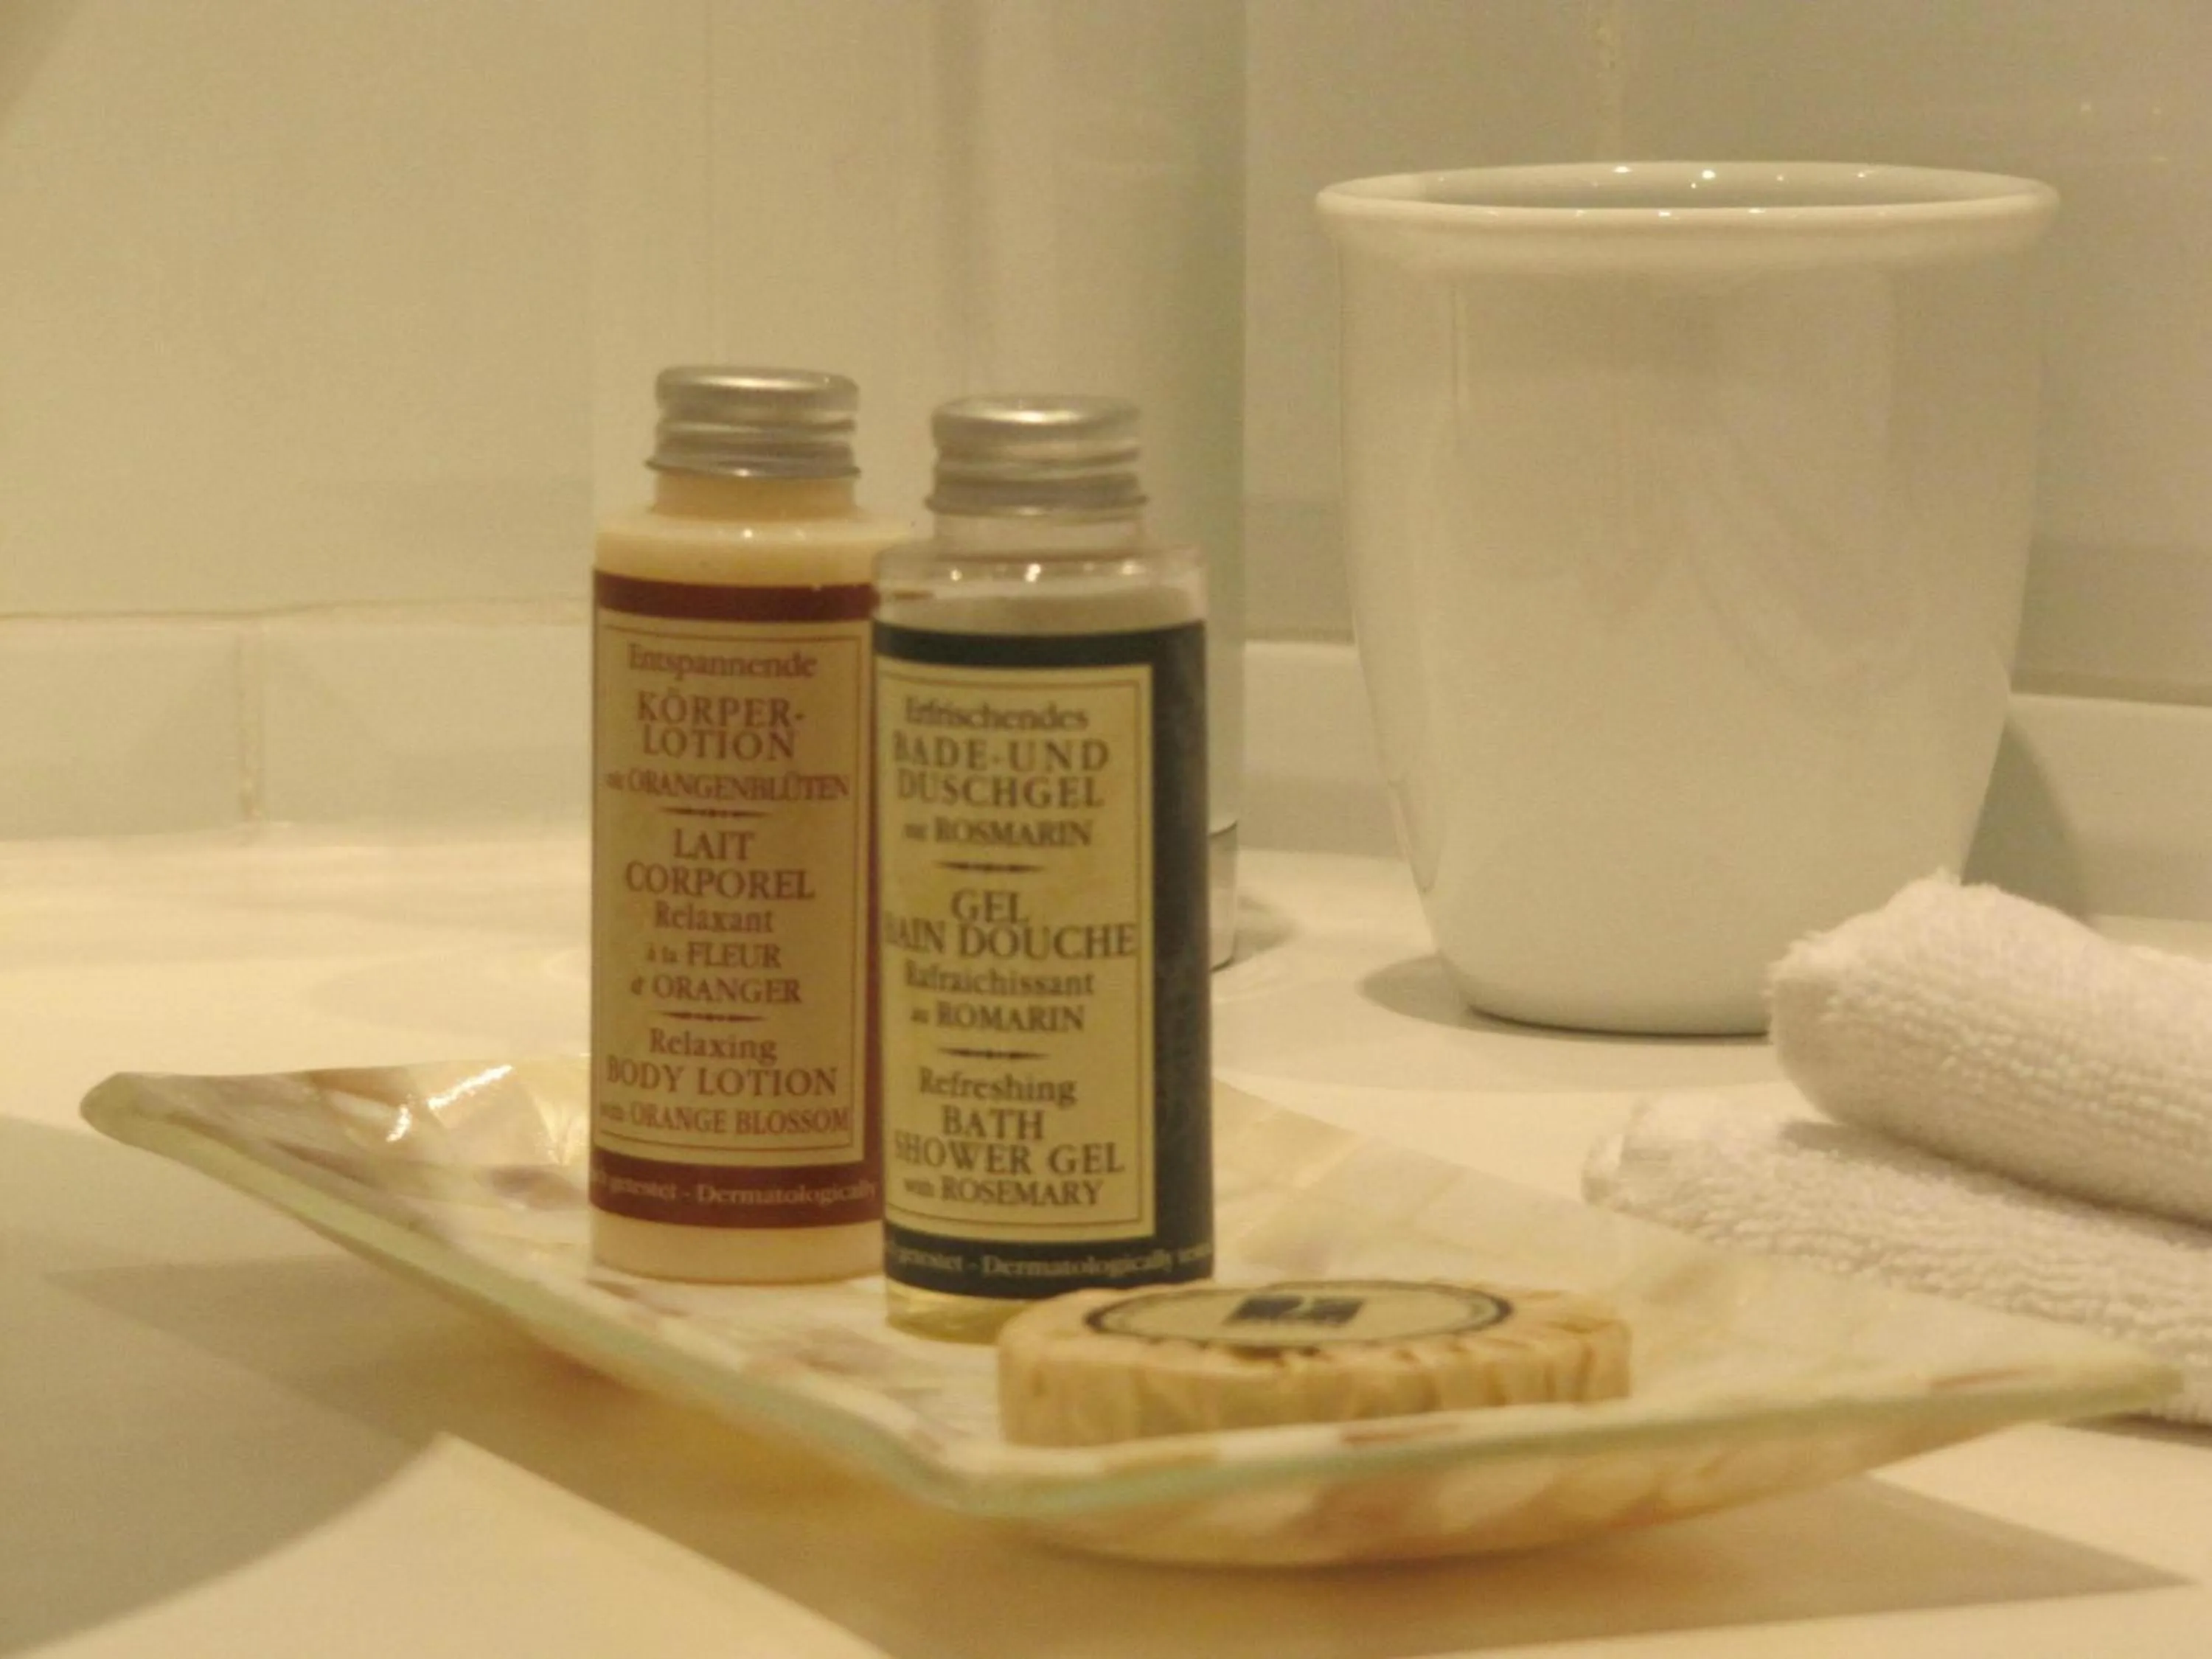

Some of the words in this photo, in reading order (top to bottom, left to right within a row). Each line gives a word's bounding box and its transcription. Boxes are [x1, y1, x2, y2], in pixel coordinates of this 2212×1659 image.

[638, 687, 805, 728] KÖRPER-
[642, 724, 796, 761] LOTION
[628, 768, 850, 801] ORANGENBLÜTEN
[897, 768, 1106, 809] DUSCHGEL
[674, 828, 756, 860] LAIT
[934, 816, 1093, 847] ROSMARIN
[626, 860, 815, 900] CORPOREL
[655, 900, 774, 933] Relaxant
[950, 889, 1029, 925] GEL
[687, 941, 782, 969] FLEUR
[959, 922, 1138, 961] DOUCHE
[652, 975, 802, 1004] ORANGER
[936, 1000, 1086, 1032] ROMARIN
[650, 1028, 778, 1064] Relaxing
[606, 1054, 684, 1093] BODY
[698, 1066, 838, 1097] LOTION
[919, 1066, 1078, 1107] Refreshing
[631, 1102, 727, 1134] ORANGE
[736, 1107, 851, 1136] BLOSSOM
[942, 1105, 1046, 1141] BATH
[894, 1129, 1034, 1176] SHOWER
[1047, 1141, 1126, 1174] GEL
[940, 1176, 1105, 1206] ROSEMARY
